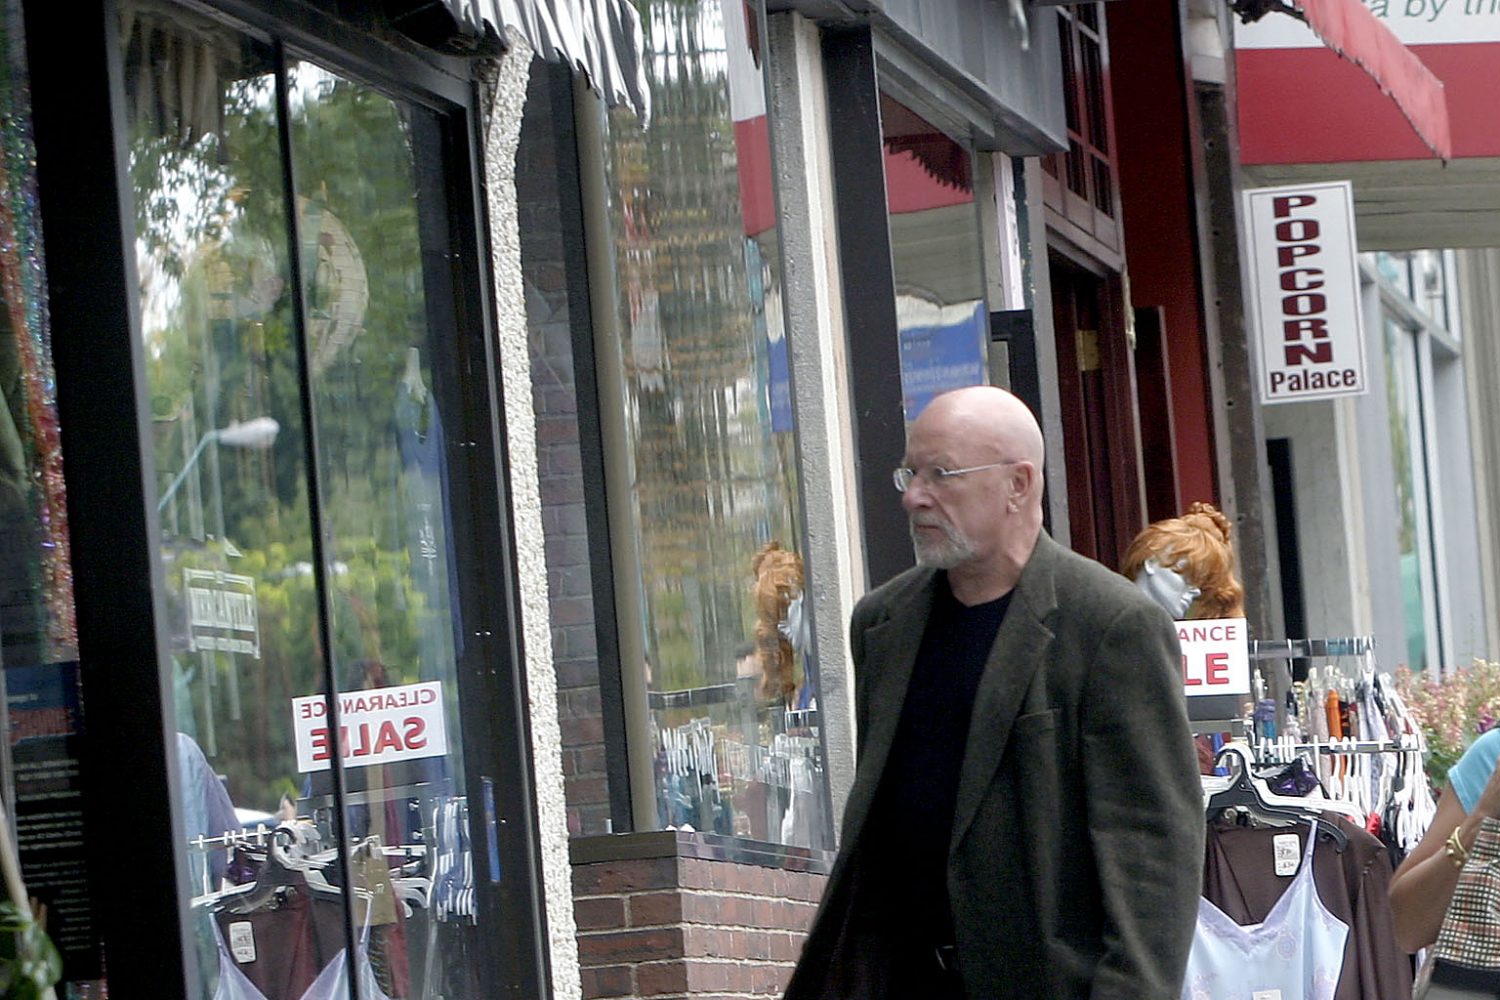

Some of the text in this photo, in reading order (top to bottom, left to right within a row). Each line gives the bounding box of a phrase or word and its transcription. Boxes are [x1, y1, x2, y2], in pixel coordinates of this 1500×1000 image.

[1405, 0, 1447, 22] by
[1272, 194, 1333, 366] POPCORN
[1270, 369, 1357, 393] Palace
